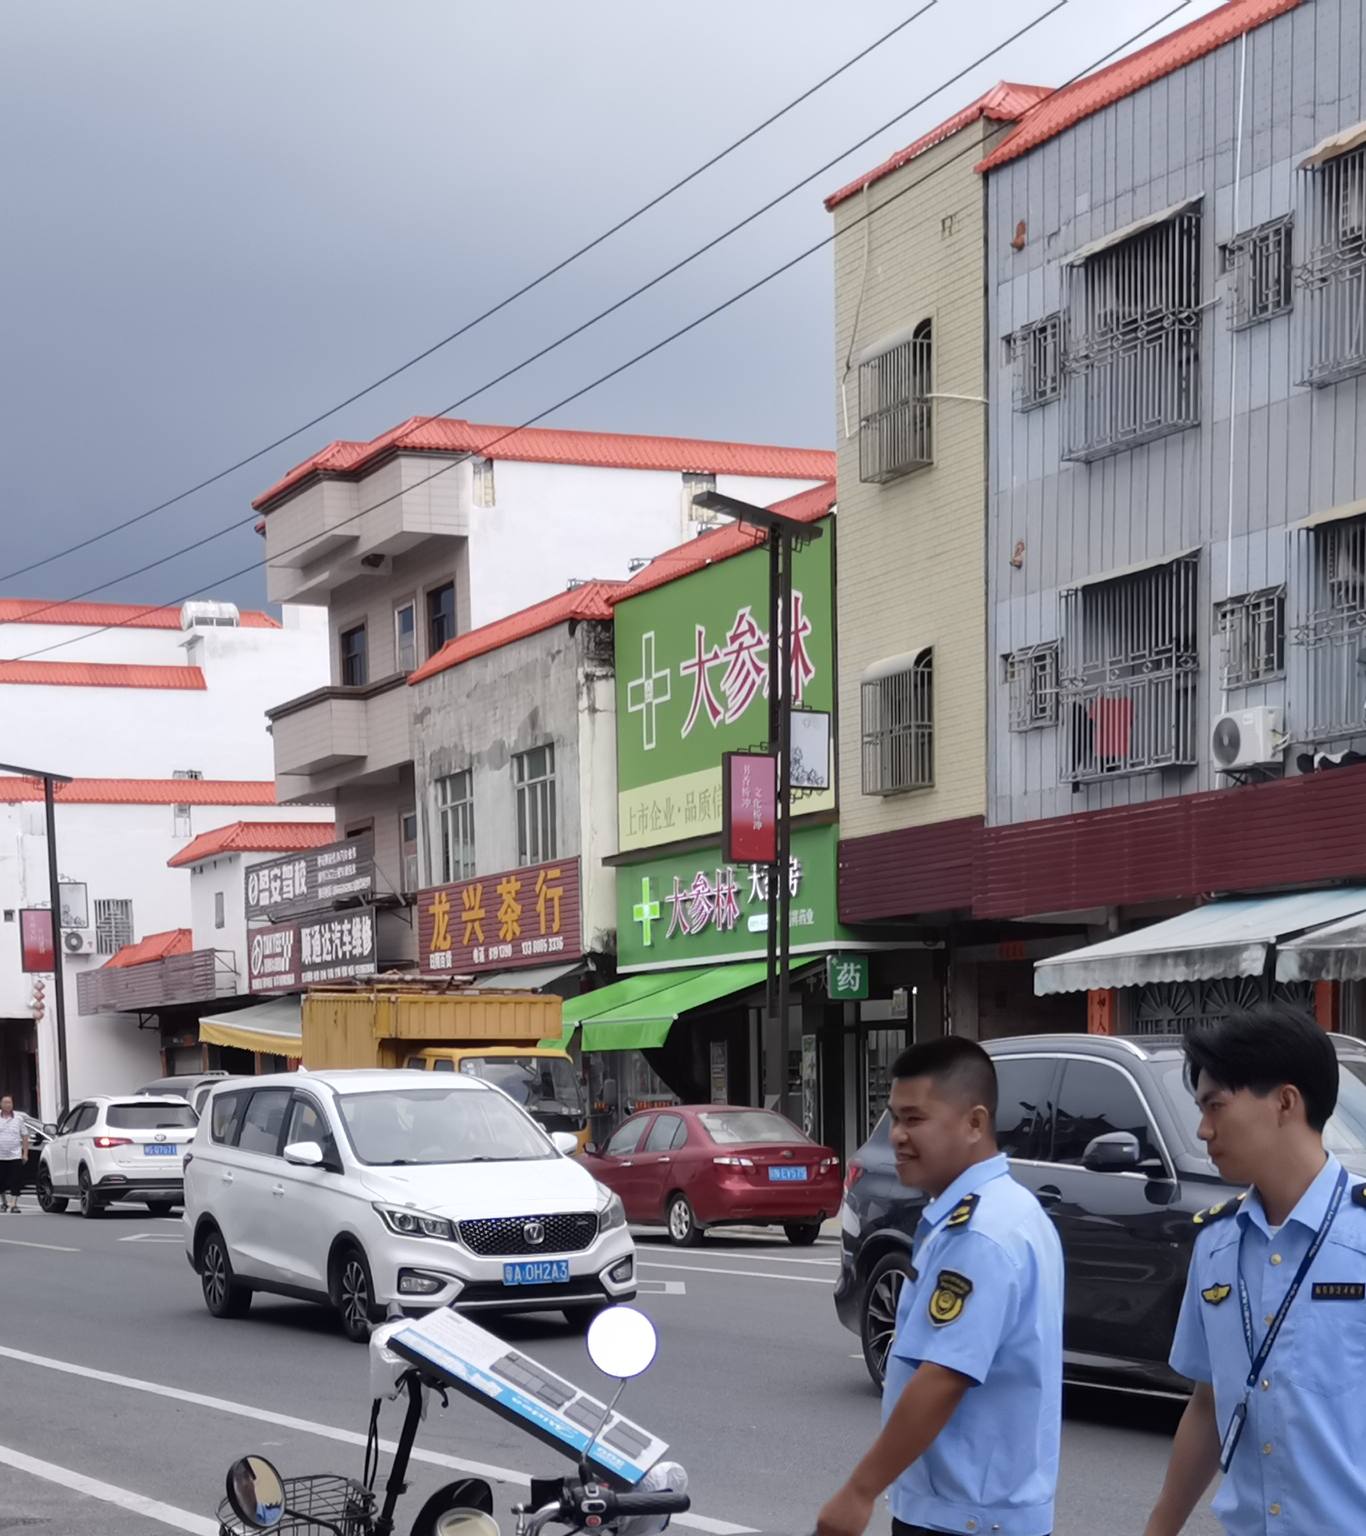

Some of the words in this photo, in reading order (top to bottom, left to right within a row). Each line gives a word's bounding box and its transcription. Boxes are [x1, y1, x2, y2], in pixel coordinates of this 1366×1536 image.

[428, 869, 564, 951] 龙兴茶行
[665, 867, 740, 939] 大参林
[300, 915, 373, 965] 顺通达汽车维修
[836, 962, 861, 992] 药
